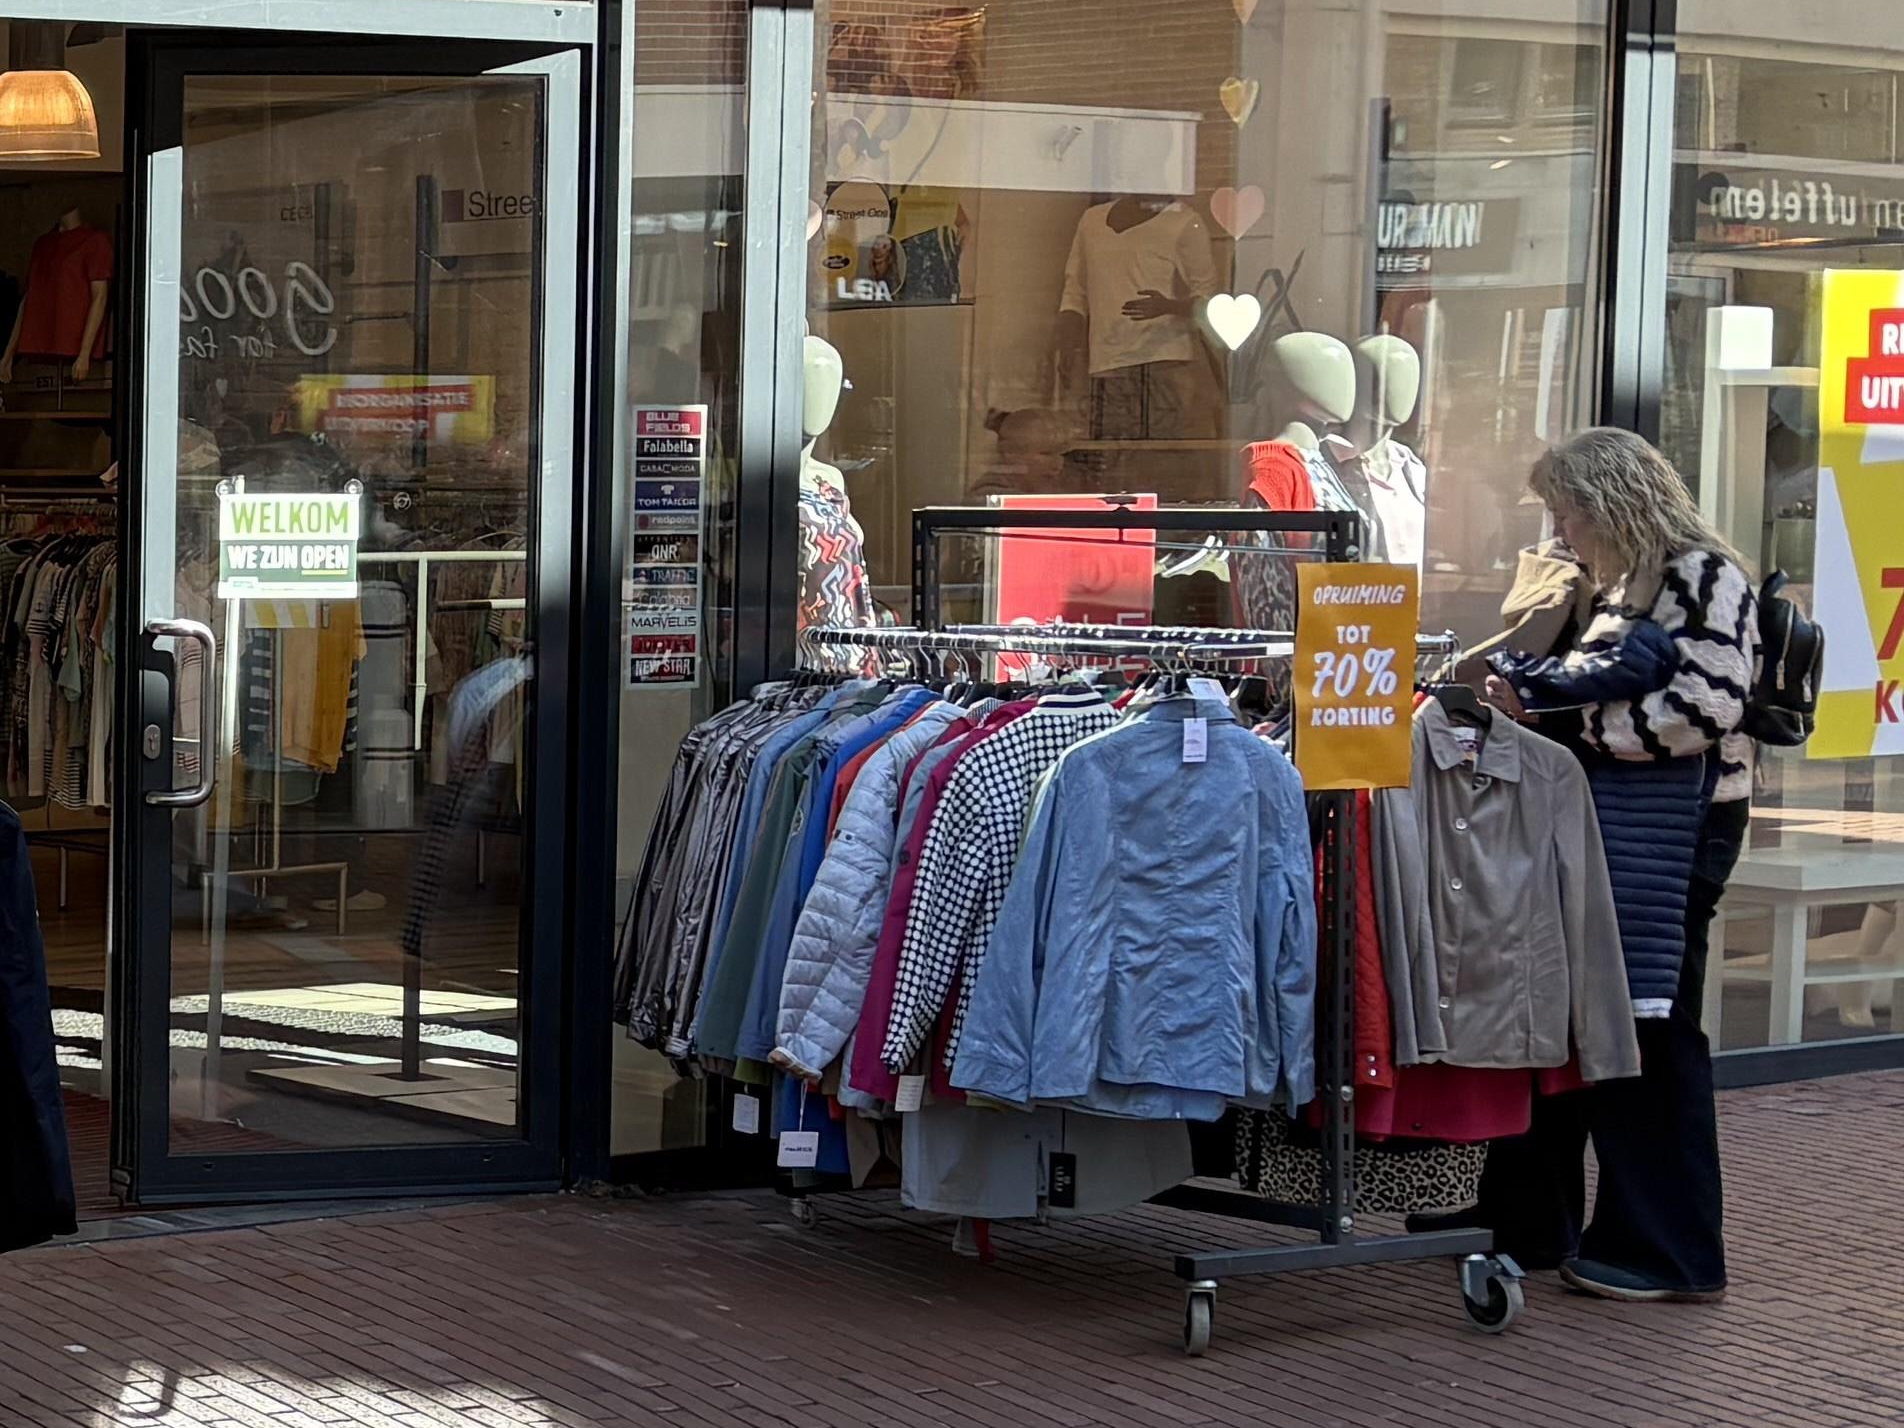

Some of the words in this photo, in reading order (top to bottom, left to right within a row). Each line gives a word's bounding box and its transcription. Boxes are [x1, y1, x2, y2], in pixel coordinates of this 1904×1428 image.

[643, 439, 694, 453] Falabella
[638, 498, 660, 507] TOM
[661, 497, 697, 506] TAILOR
[230, 501, 349, 534] WELKOM
[227, 545, 258, 569] WE
[259, 545, 298, 569] ZIJN
[301, 544, 350, 570] OPEN
[1313, 584, 1406, 605] OPRUIMING
[632, 616, 697, 629] MARVELIS
[1336, 625, 1372, 644] TOT
[635, 659, 660, 677] NEW
[663, 658, 690, 676] STAR
[1311, 648, 1398, 698] 70%
[1311, 707, 1396, 726] KORTING
